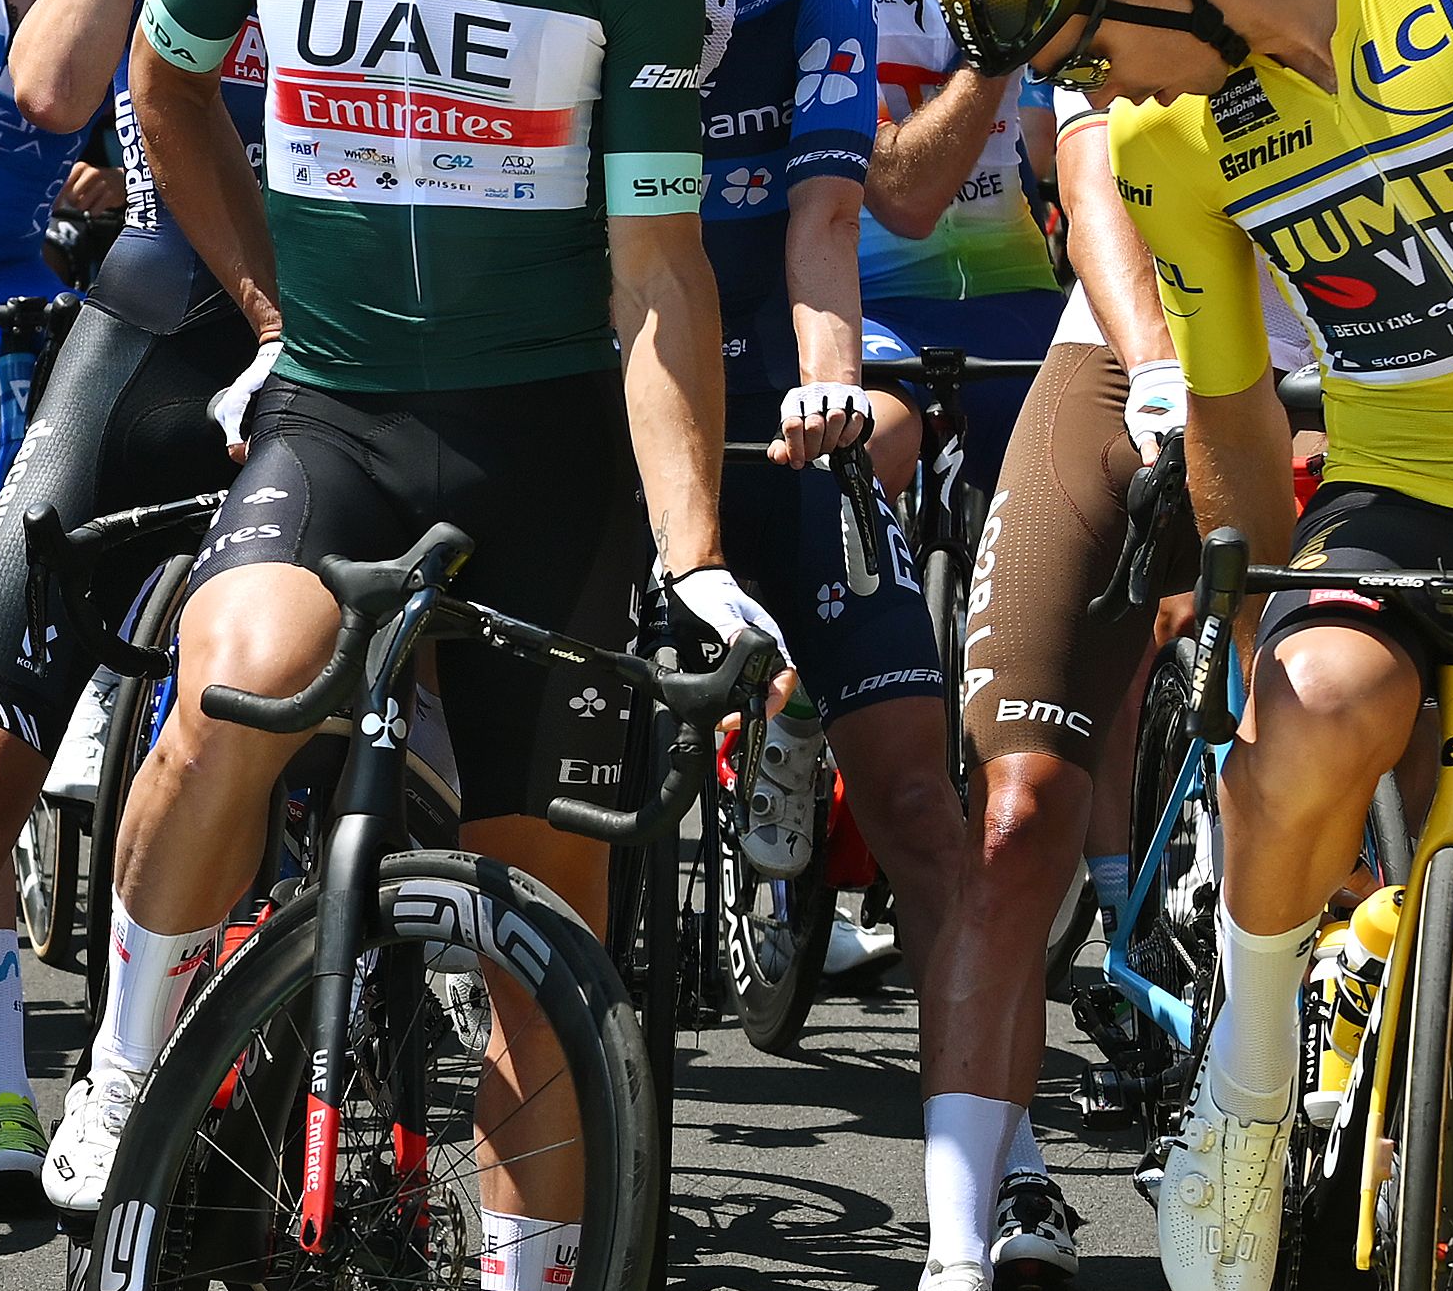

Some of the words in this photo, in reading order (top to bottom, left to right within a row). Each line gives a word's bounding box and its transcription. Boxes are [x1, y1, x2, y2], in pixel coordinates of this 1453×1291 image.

[299, 85, 513, 141] Emirates
[1219, 120, 1312, 182] Santini
[1357, 575, 1425, 589] cervélo
[548, 647, 586, 665] wahoo
[1188, 614, 1222, 711] SRAM
[995, 697, 1094, 739] BMC
[311, 1048, 329, 1094] UAE
[305, 1109, 327, 1192] Emirates
